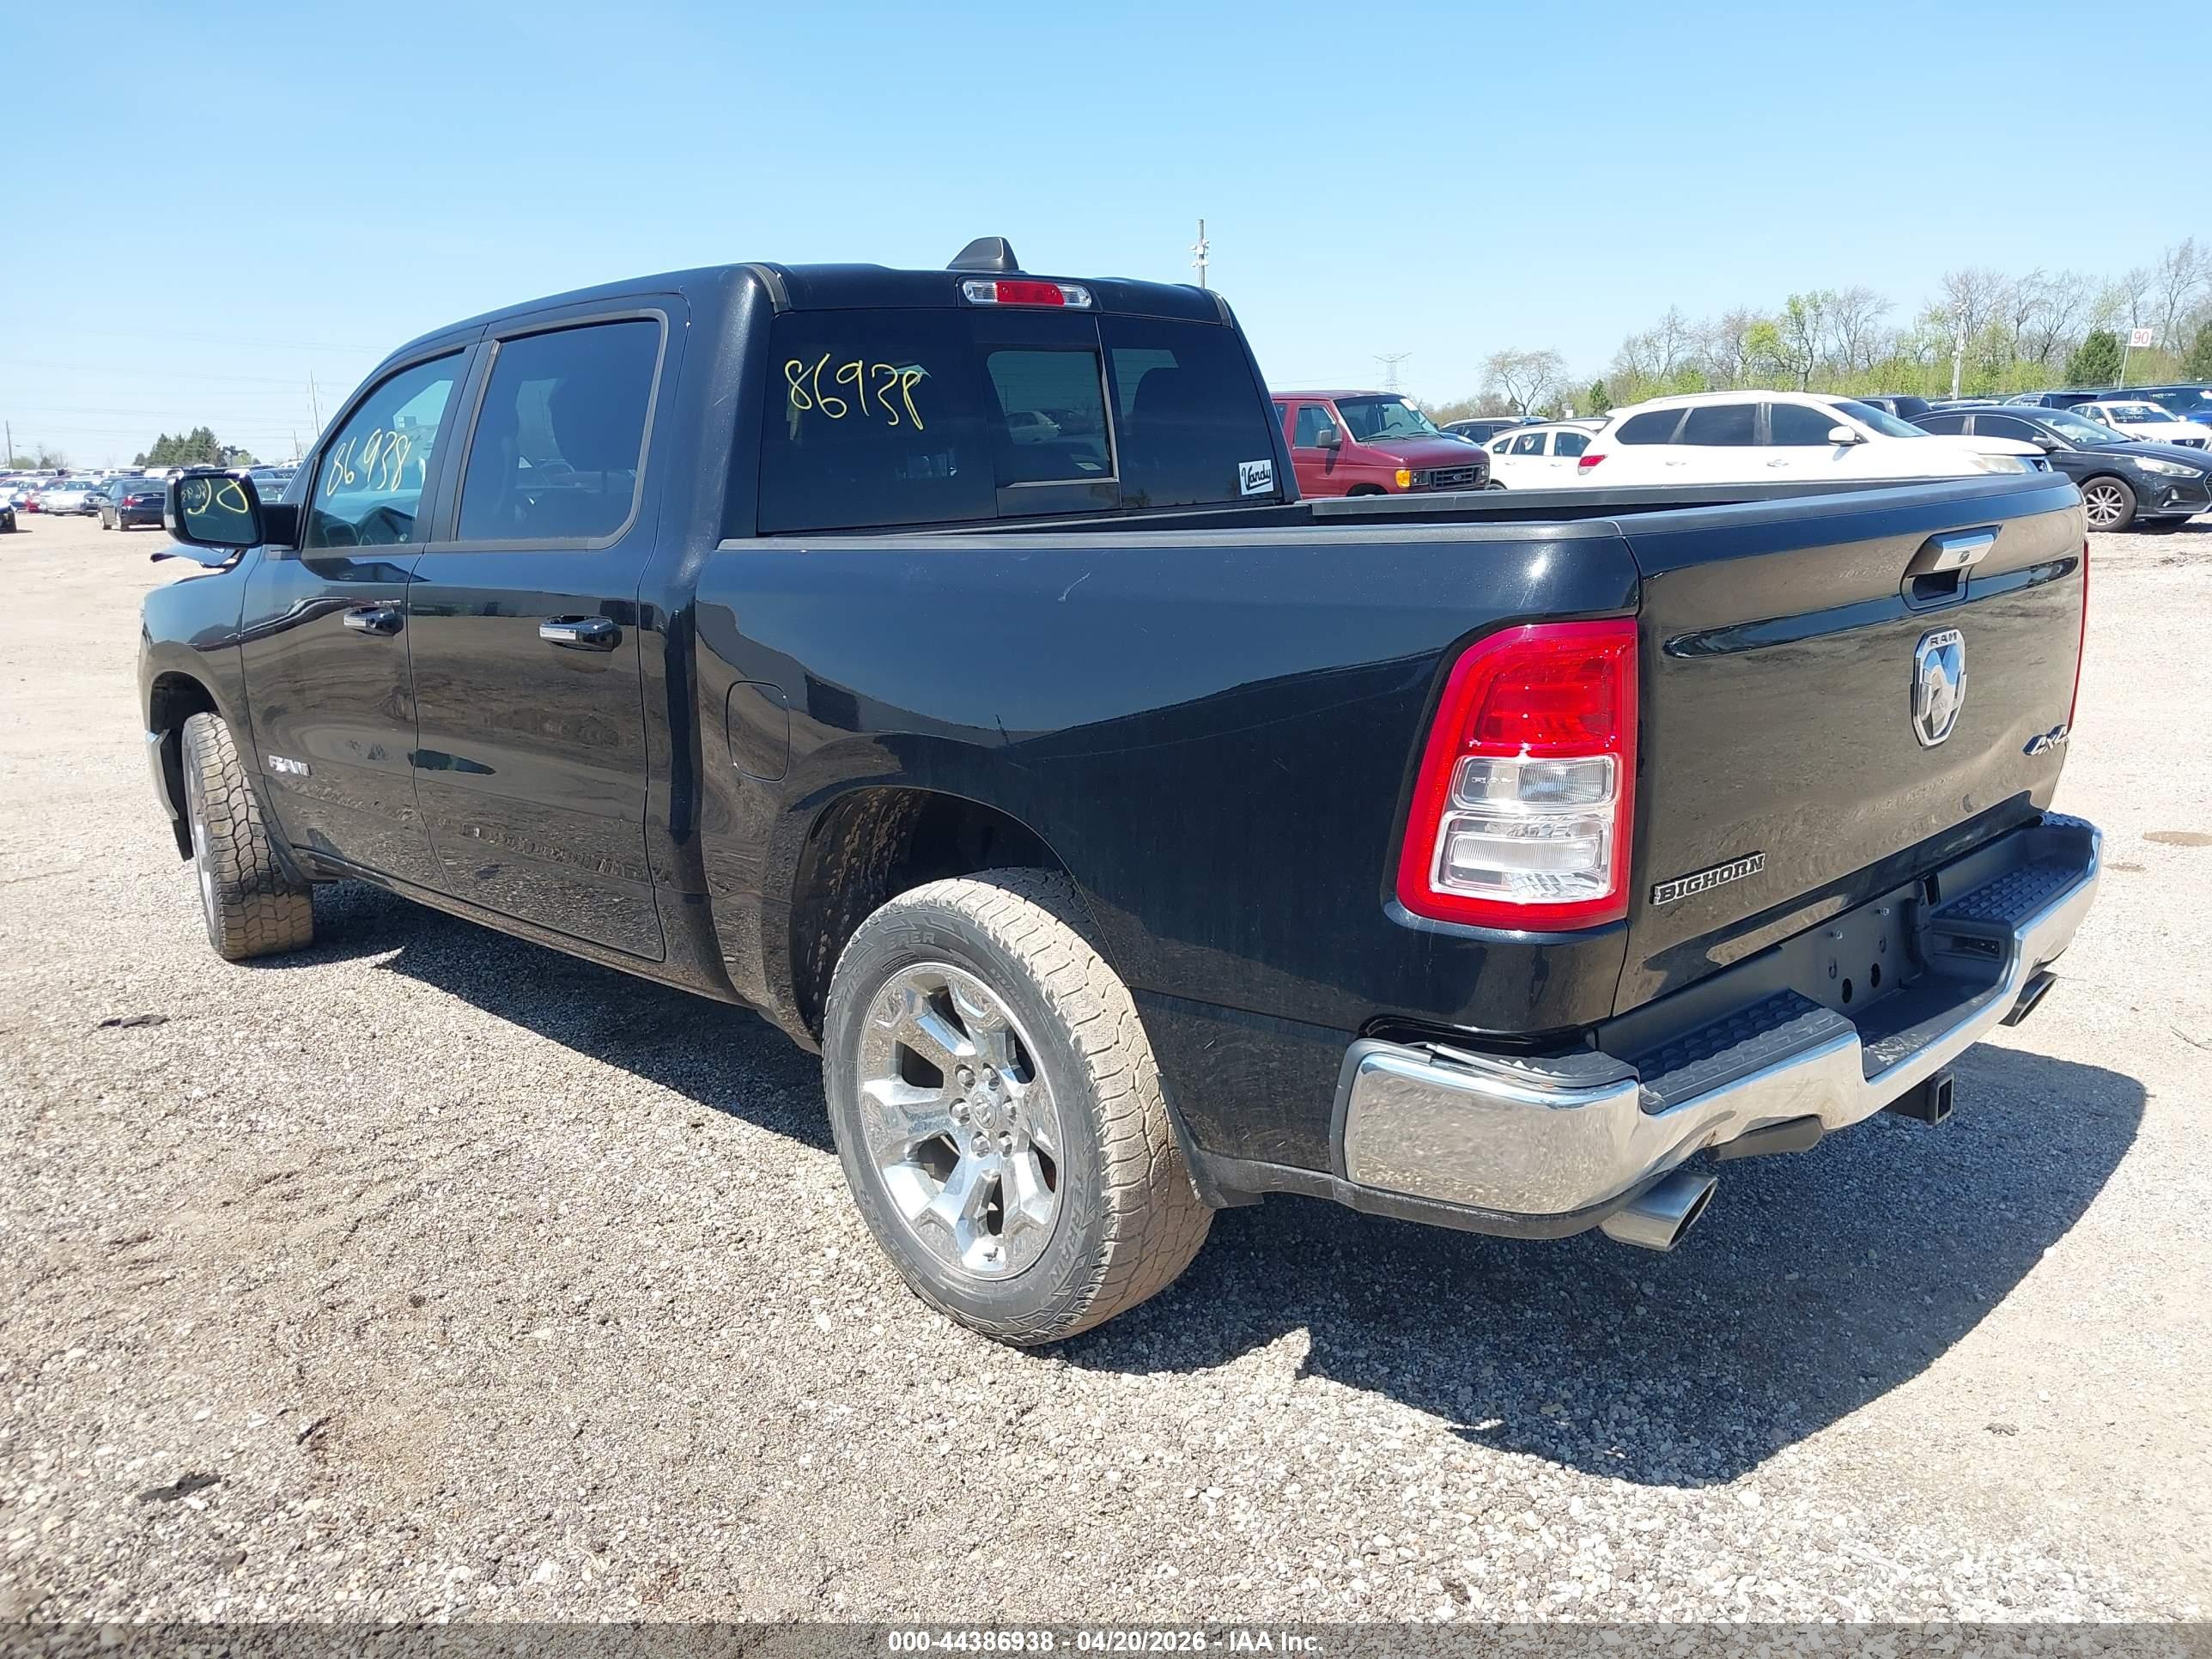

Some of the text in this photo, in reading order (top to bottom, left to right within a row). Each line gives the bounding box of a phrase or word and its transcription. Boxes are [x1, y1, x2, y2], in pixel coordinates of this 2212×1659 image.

[327, 428, 412, 497] 86938
[1241, 464, 1272, 491] Vandy
[1929, 632, 1958, 646] RAM
[1650, 851, 1765, 906] BIGHORN
